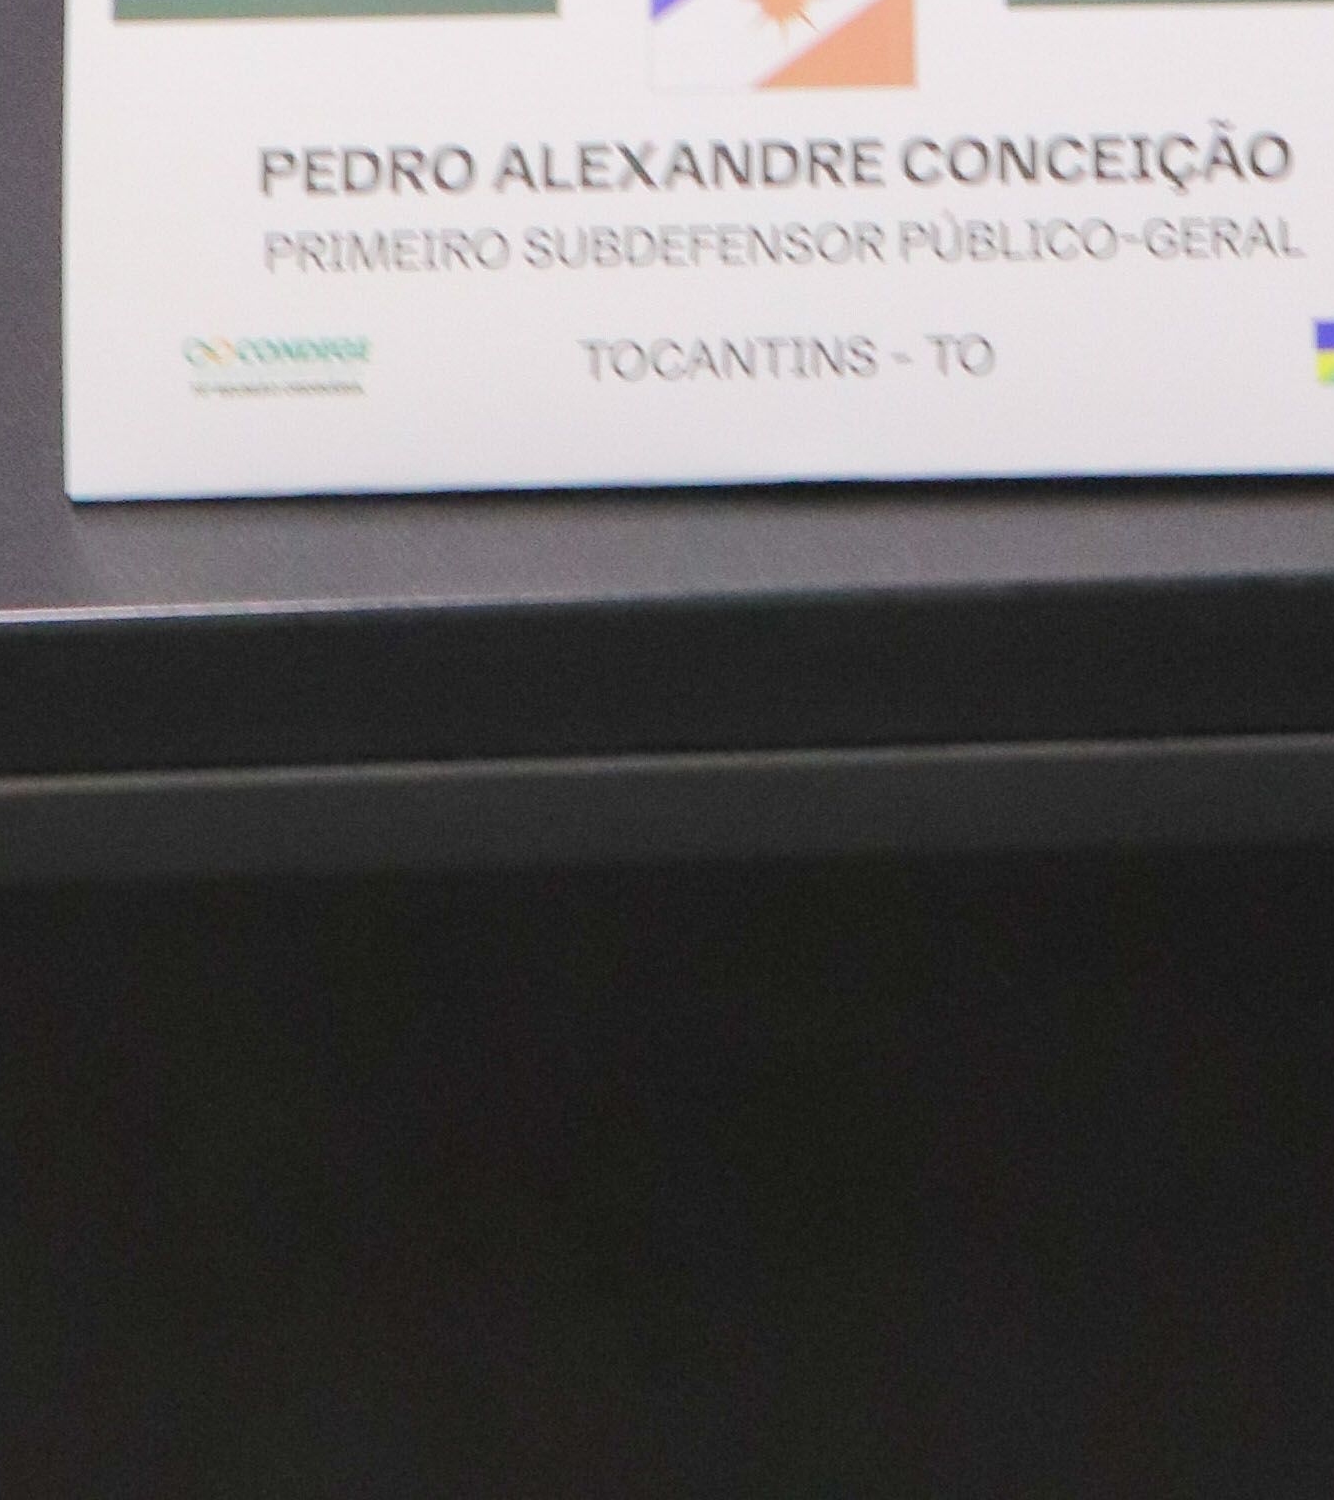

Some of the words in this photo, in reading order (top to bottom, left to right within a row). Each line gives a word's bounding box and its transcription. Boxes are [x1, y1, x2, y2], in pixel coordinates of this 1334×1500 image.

[259, 143, 474, 195] PEDRO
[493, 137, 885, 192] ALEXANDRE
[902, 118, 1293, 195] CONCEIÇÃO
[265, 228, 510, 274] PRIMEIRO
[524, 221, 886, 270] SUBDEFENSOR
[578, 334, 880, 381] TOCANTINS
[924, 332, 995, 378] TO
